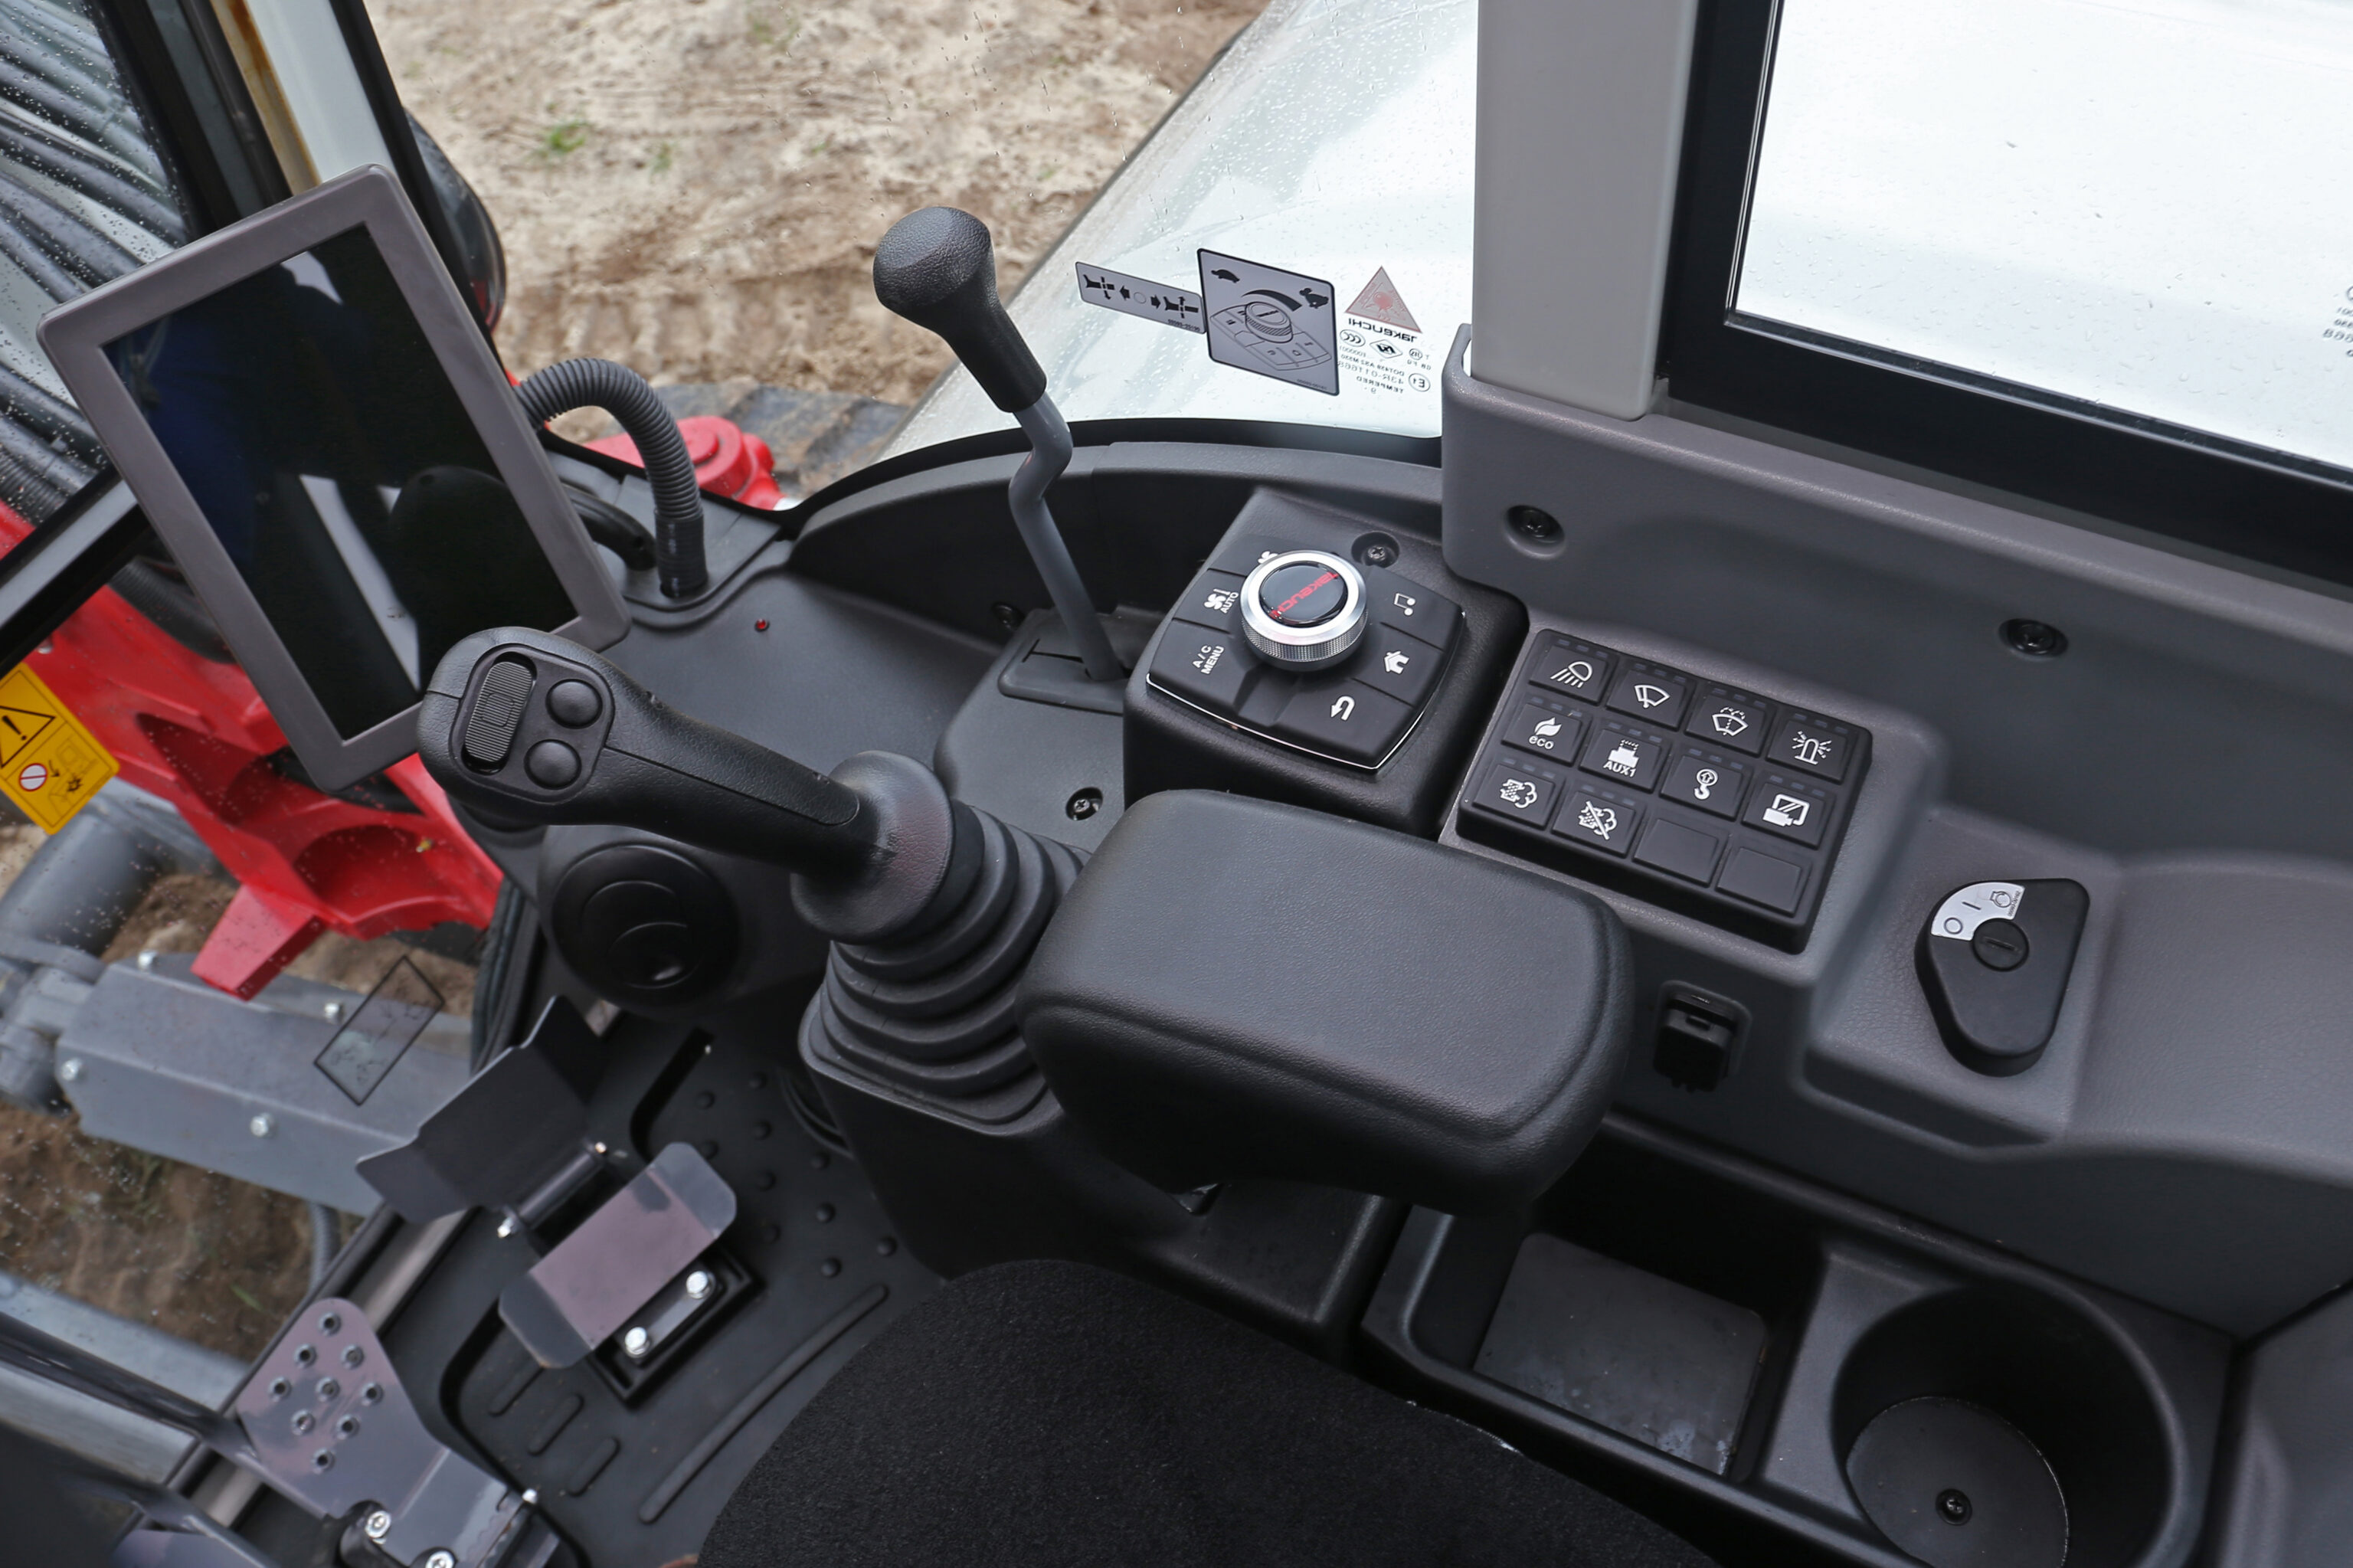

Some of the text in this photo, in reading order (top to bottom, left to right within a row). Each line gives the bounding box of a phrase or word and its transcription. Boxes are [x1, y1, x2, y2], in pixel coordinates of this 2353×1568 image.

[1220, 592, 1239, 614] AUTO
[1200, 646, 1225, 675] MENU
[1528, 735, 1554, 750] eco
[1603, 761, 1637, 778] AUX1
